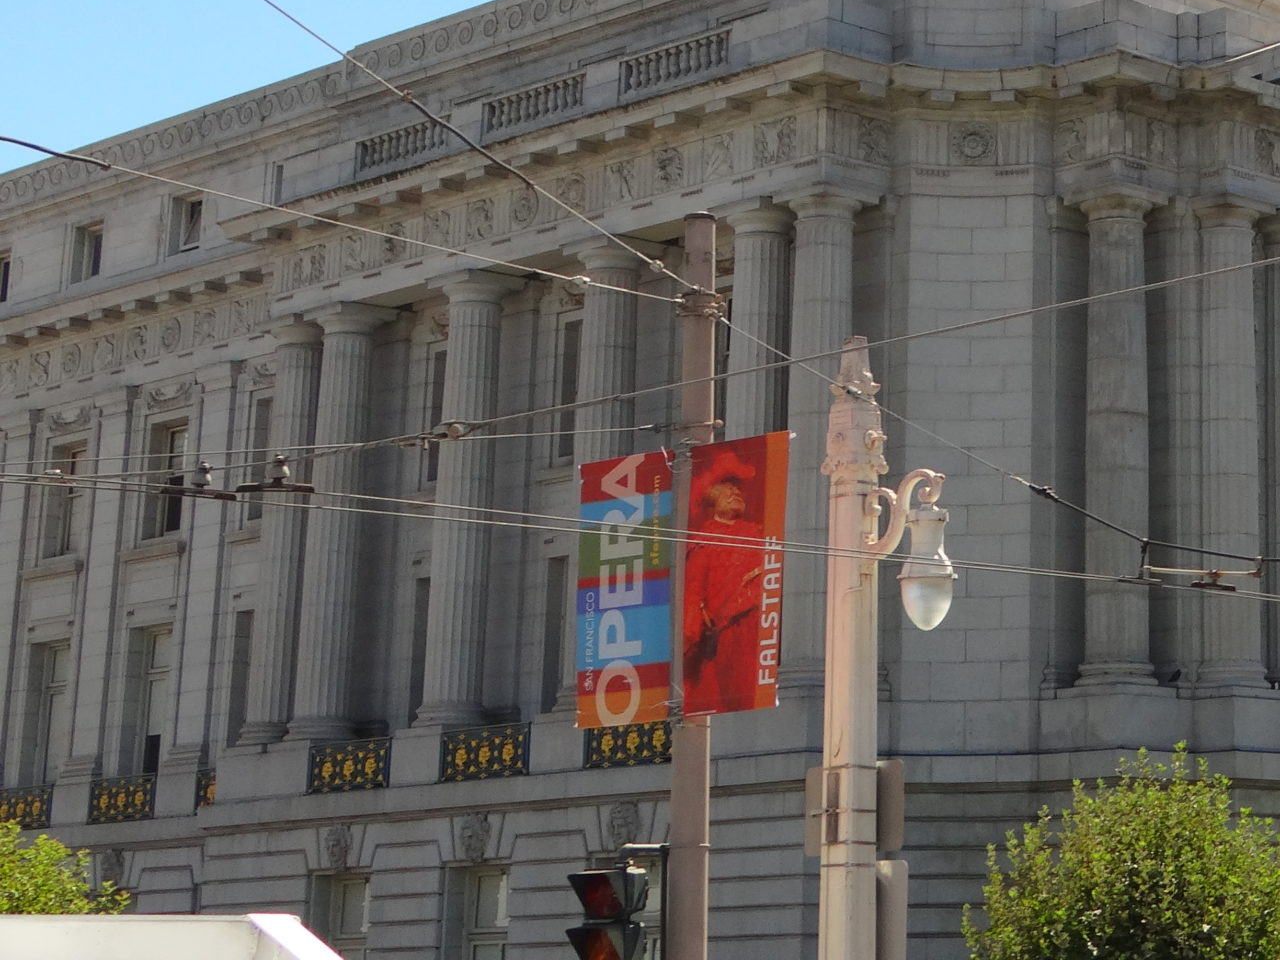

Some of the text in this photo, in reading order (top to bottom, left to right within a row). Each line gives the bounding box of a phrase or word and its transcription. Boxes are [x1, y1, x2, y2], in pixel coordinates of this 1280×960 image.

[585, 591, 596, 692] SAN FRANCISCO
[595, 453, 645, 726] OPERA
[758, 536, 783, 686] FALSTAFF
